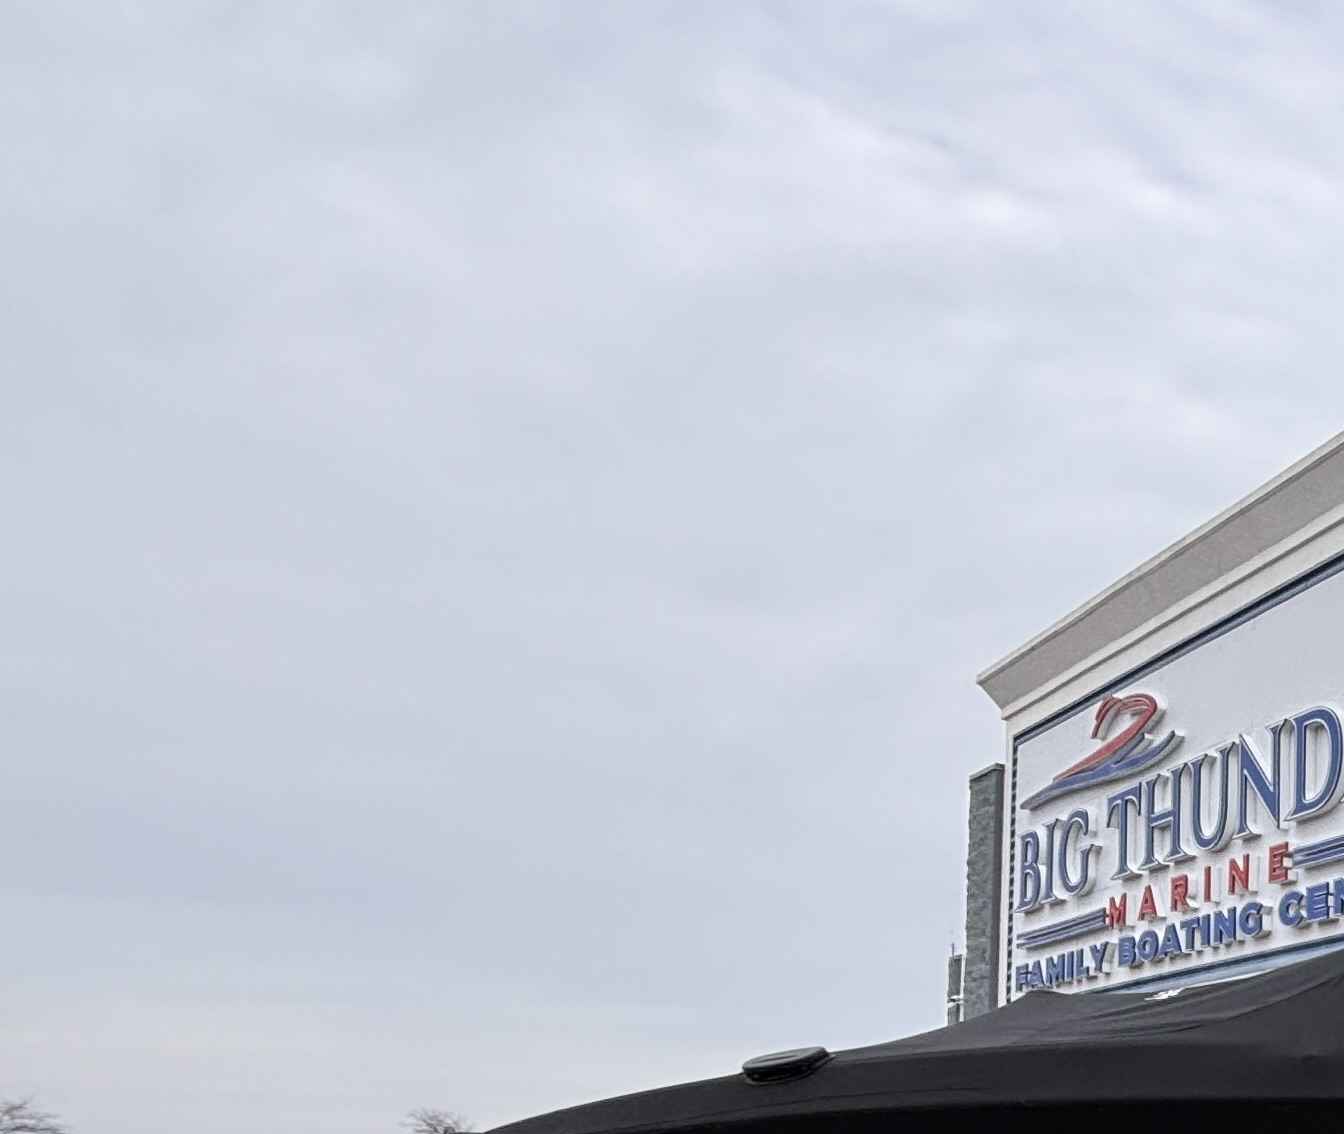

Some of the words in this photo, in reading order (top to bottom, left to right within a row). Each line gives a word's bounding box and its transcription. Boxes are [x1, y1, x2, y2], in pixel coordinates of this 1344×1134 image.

[1015, 808, 1099, 913] BIG
[1106, 841, 1290, 929] MARINE
[1015, 941, 1110, 992] FAMILY
[1118, 901, 1268, 968] BOATING
